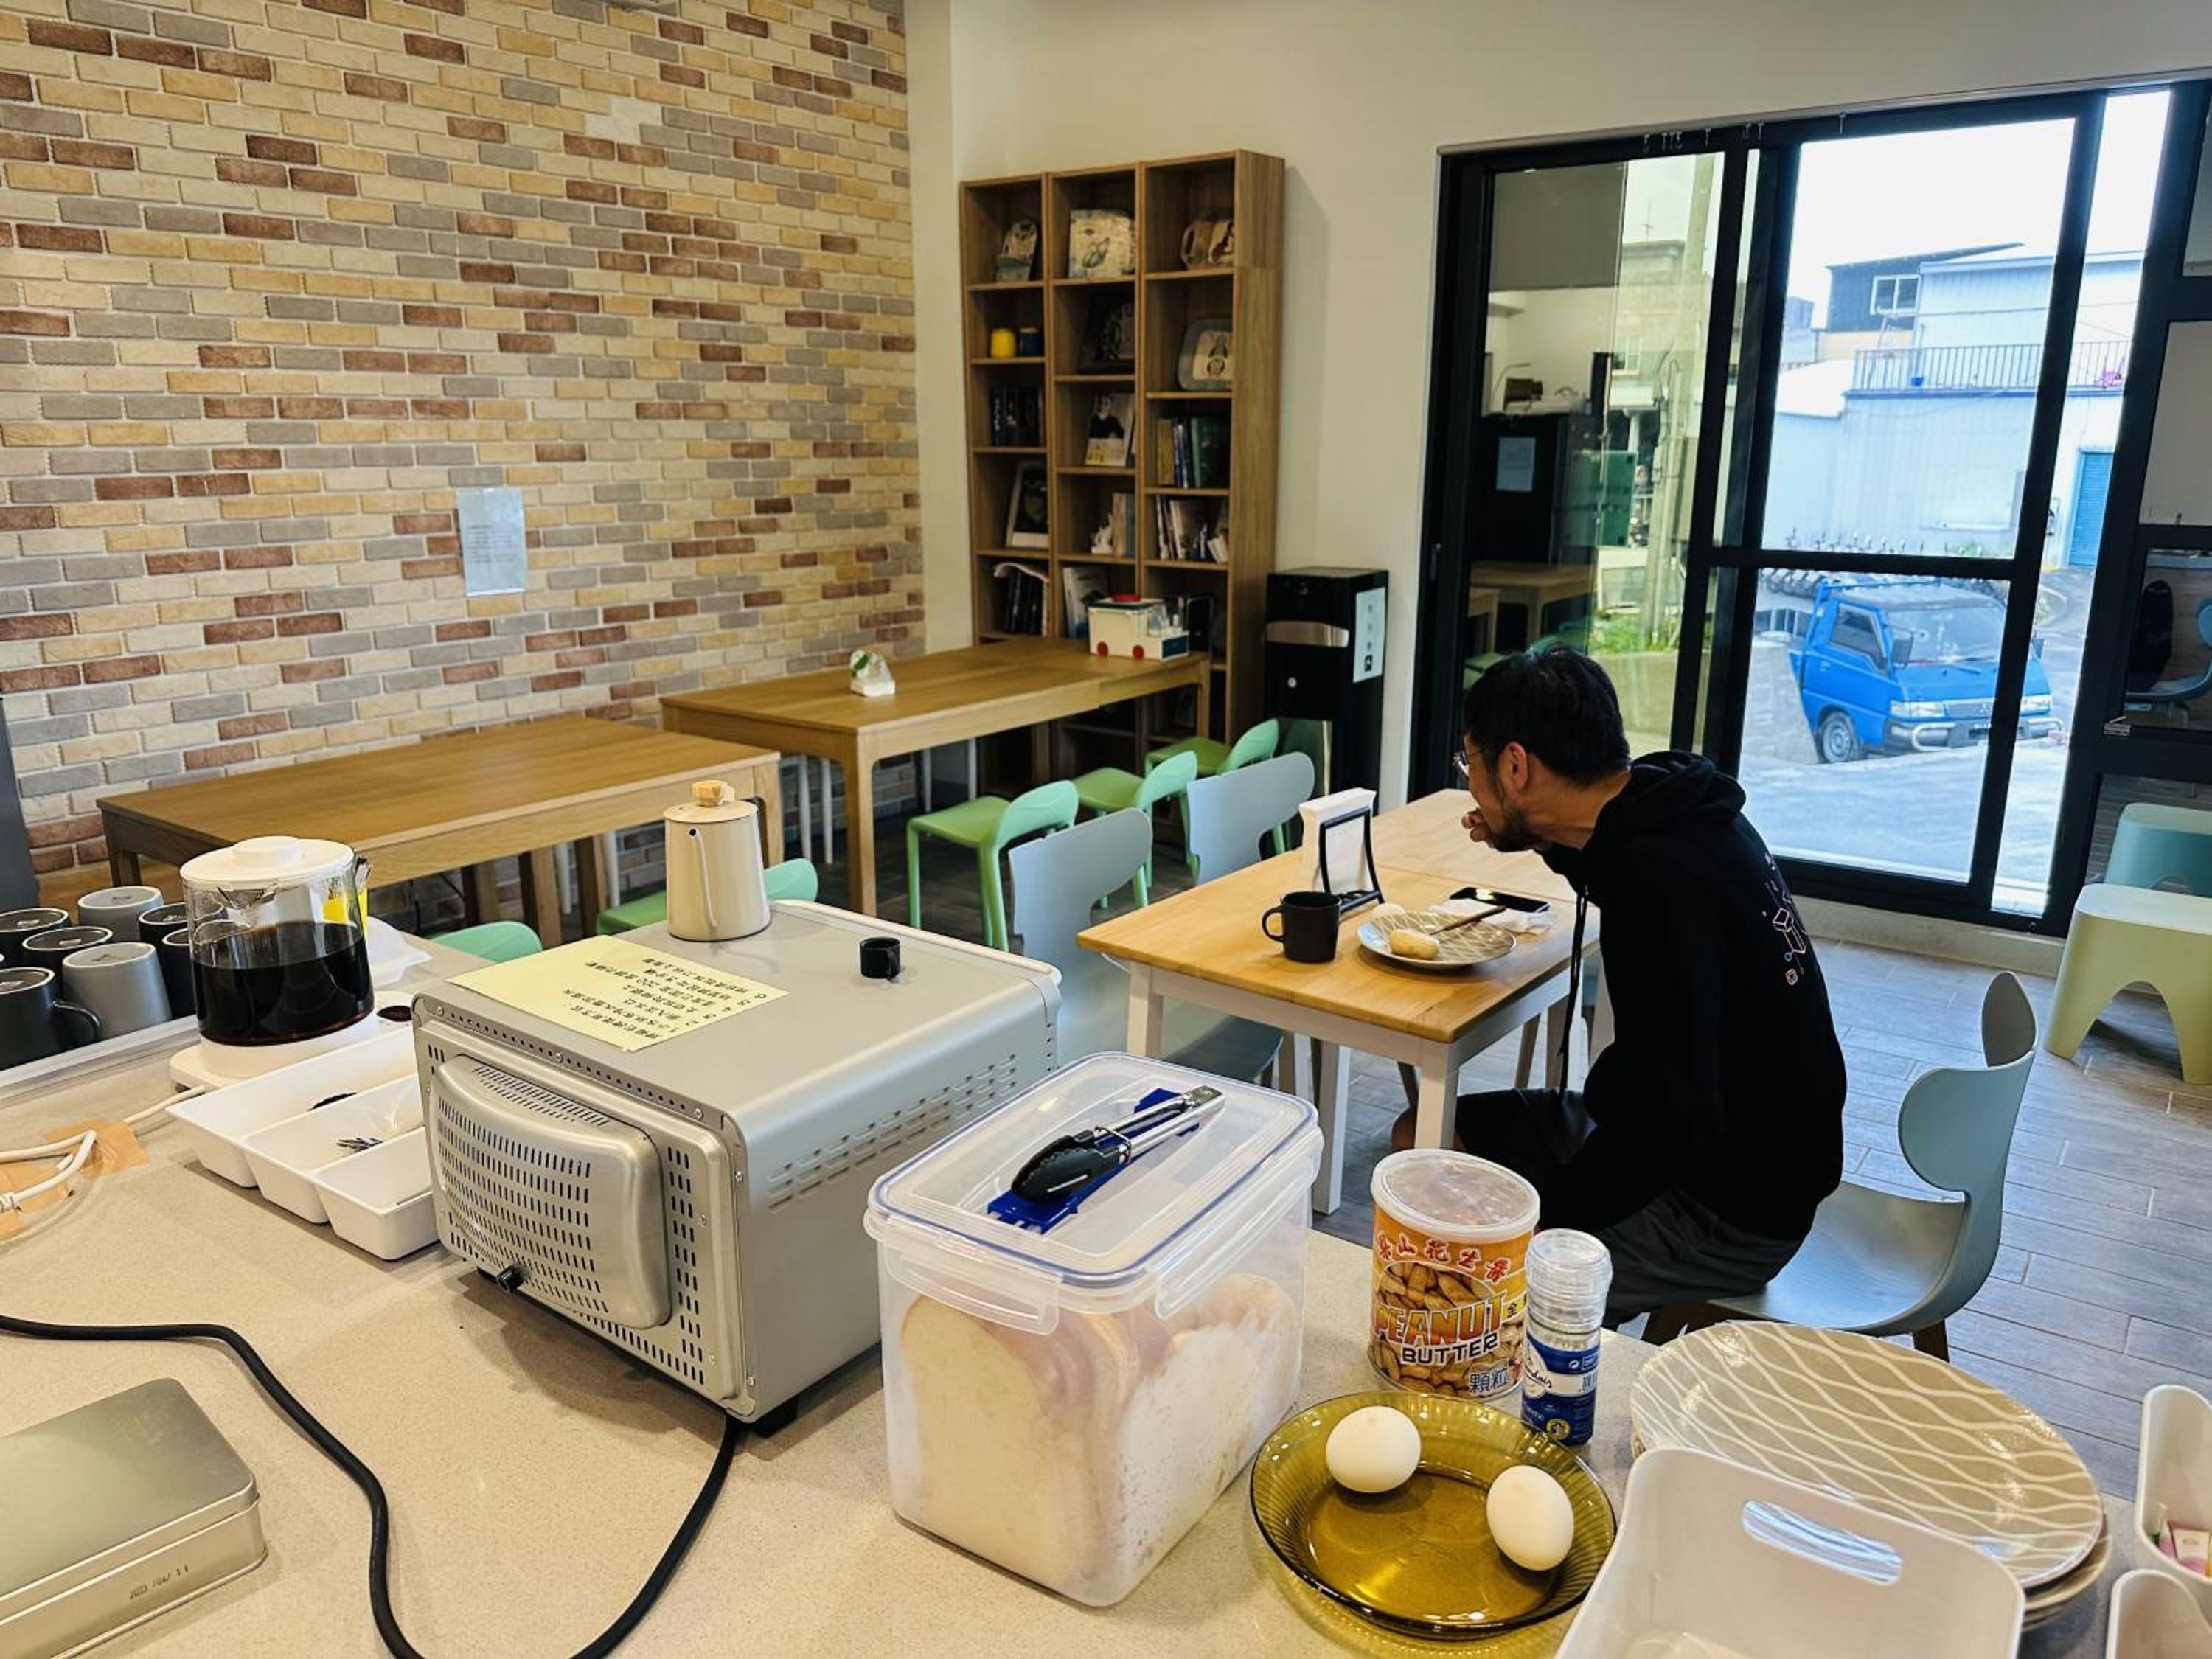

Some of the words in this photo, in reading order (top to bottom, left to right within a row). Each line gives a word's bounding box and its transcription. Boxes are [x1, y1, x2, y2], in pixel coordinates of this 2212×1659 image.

[1374, 1290, 1505, 1346] PEANUT
[1402, 1332, 1498, 1364] BUTTER
[1469, 1368, 1509, 1392] 顆粒
